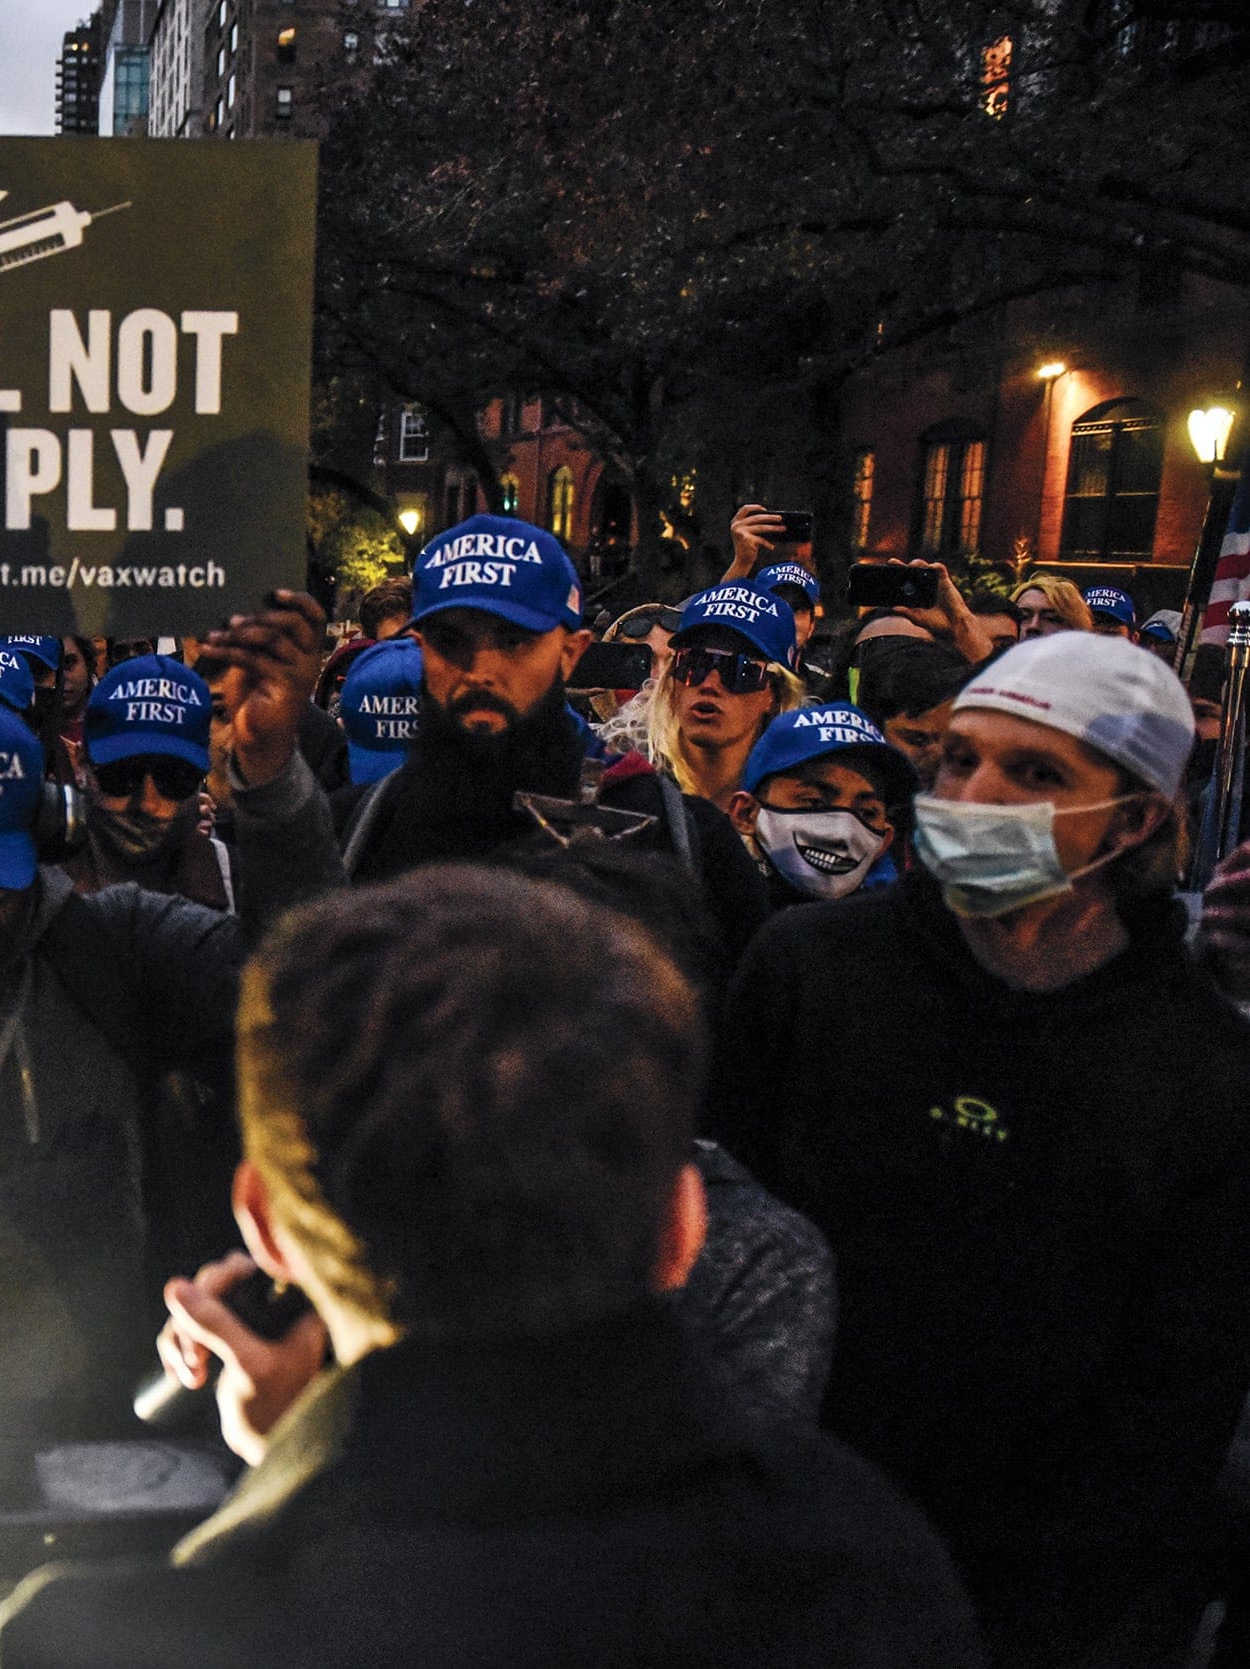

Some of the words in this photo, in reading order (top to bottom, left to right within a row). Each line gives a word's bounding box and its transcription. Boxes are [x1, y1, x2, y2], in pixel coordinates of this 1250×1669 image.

[50, 308, 239, 416] NOT
[424, 533, 543, 569] AMERICA
[0, 558, 225, 589] t.me/vaxwatch
[438, 561, 517, 589] FIRST
[767, 565, 815, 586] AMERICA
[776, 574, 808, 588] FIRST
[694, 587, 779, 618] AMERICA
[1085, 588, 1127, 603] MERICA
[702, 602, 761, 623] FIRST
[108, 678, 203, 706] AMERICA
[358, 694, 421, 715] AMER
[125, 702, 186, 725] FIRST
